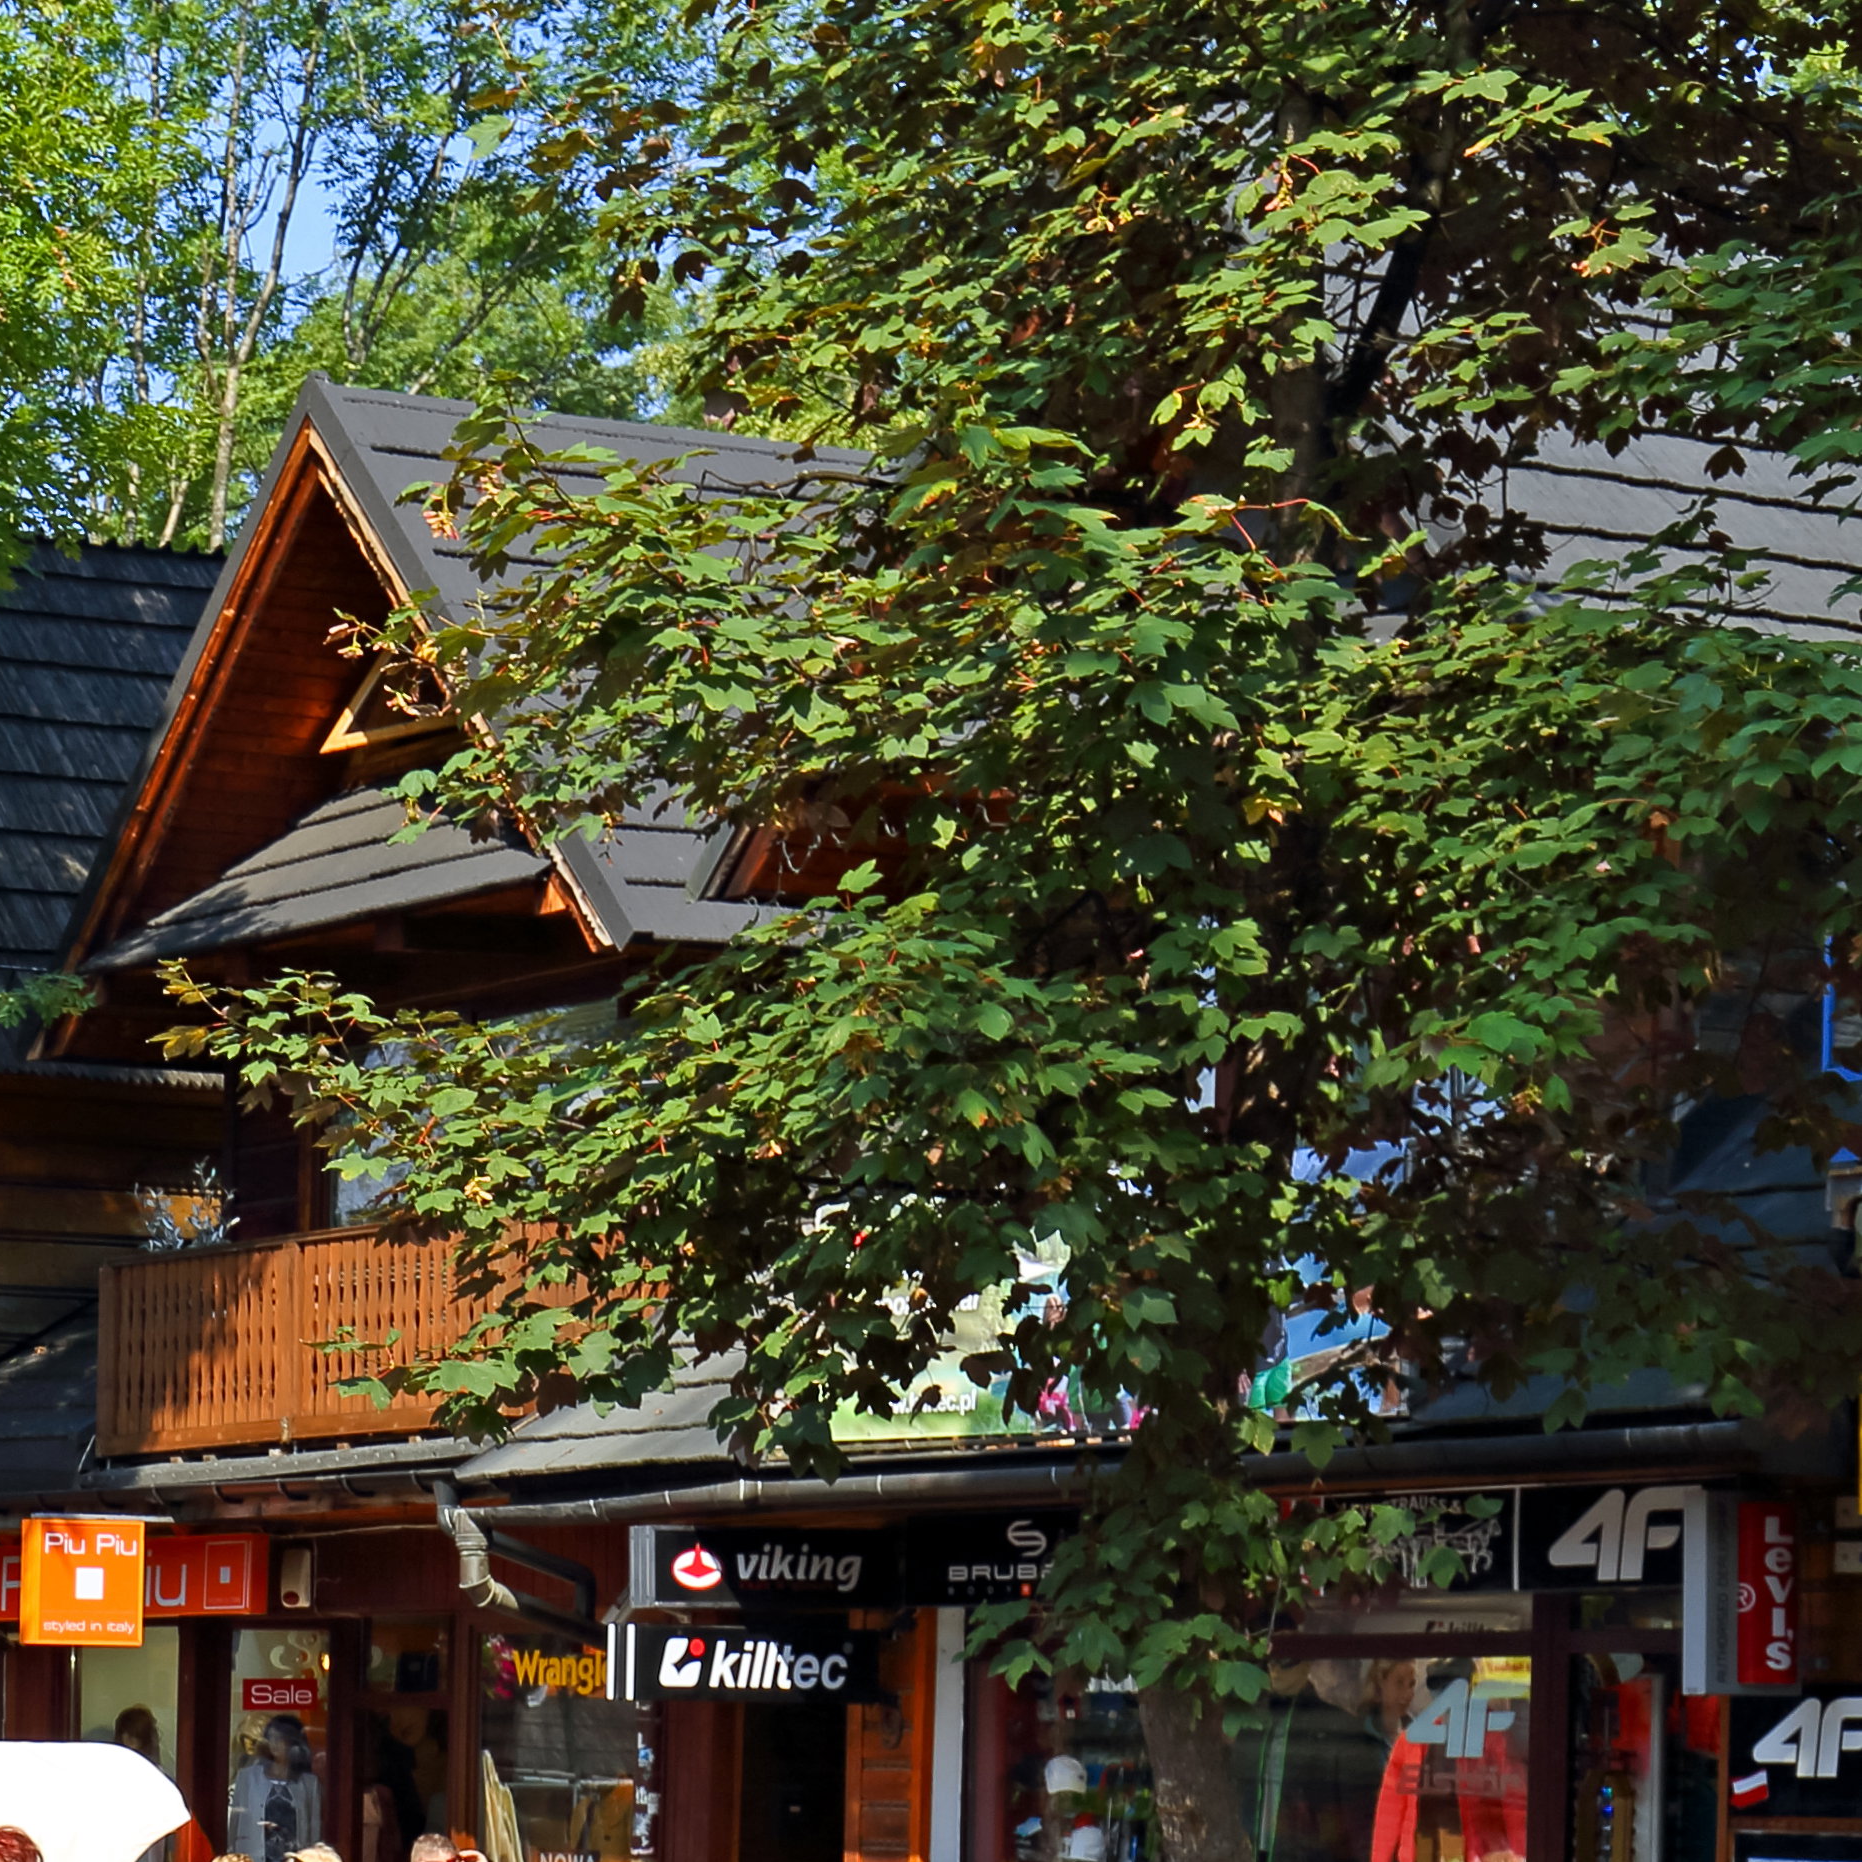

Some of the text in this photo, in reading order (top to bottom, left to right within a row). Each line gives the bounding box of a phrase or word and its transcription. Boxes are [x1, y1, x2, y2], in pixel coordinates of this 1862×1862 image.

[44, 1532, 137, 1557] Piu Piu
[1548, 1486, 1683, 1581] 4F
[145, 1551, 187, 1608] iu
[737, 1543, 862, 1592] viking
[43, 1621, 135, 1635] styled in italy
[708, 1640, 849, 1691] killtec
[251, 1684, 313, 1704] Sale
[1405, 1677, 1531, 1758] 4F
